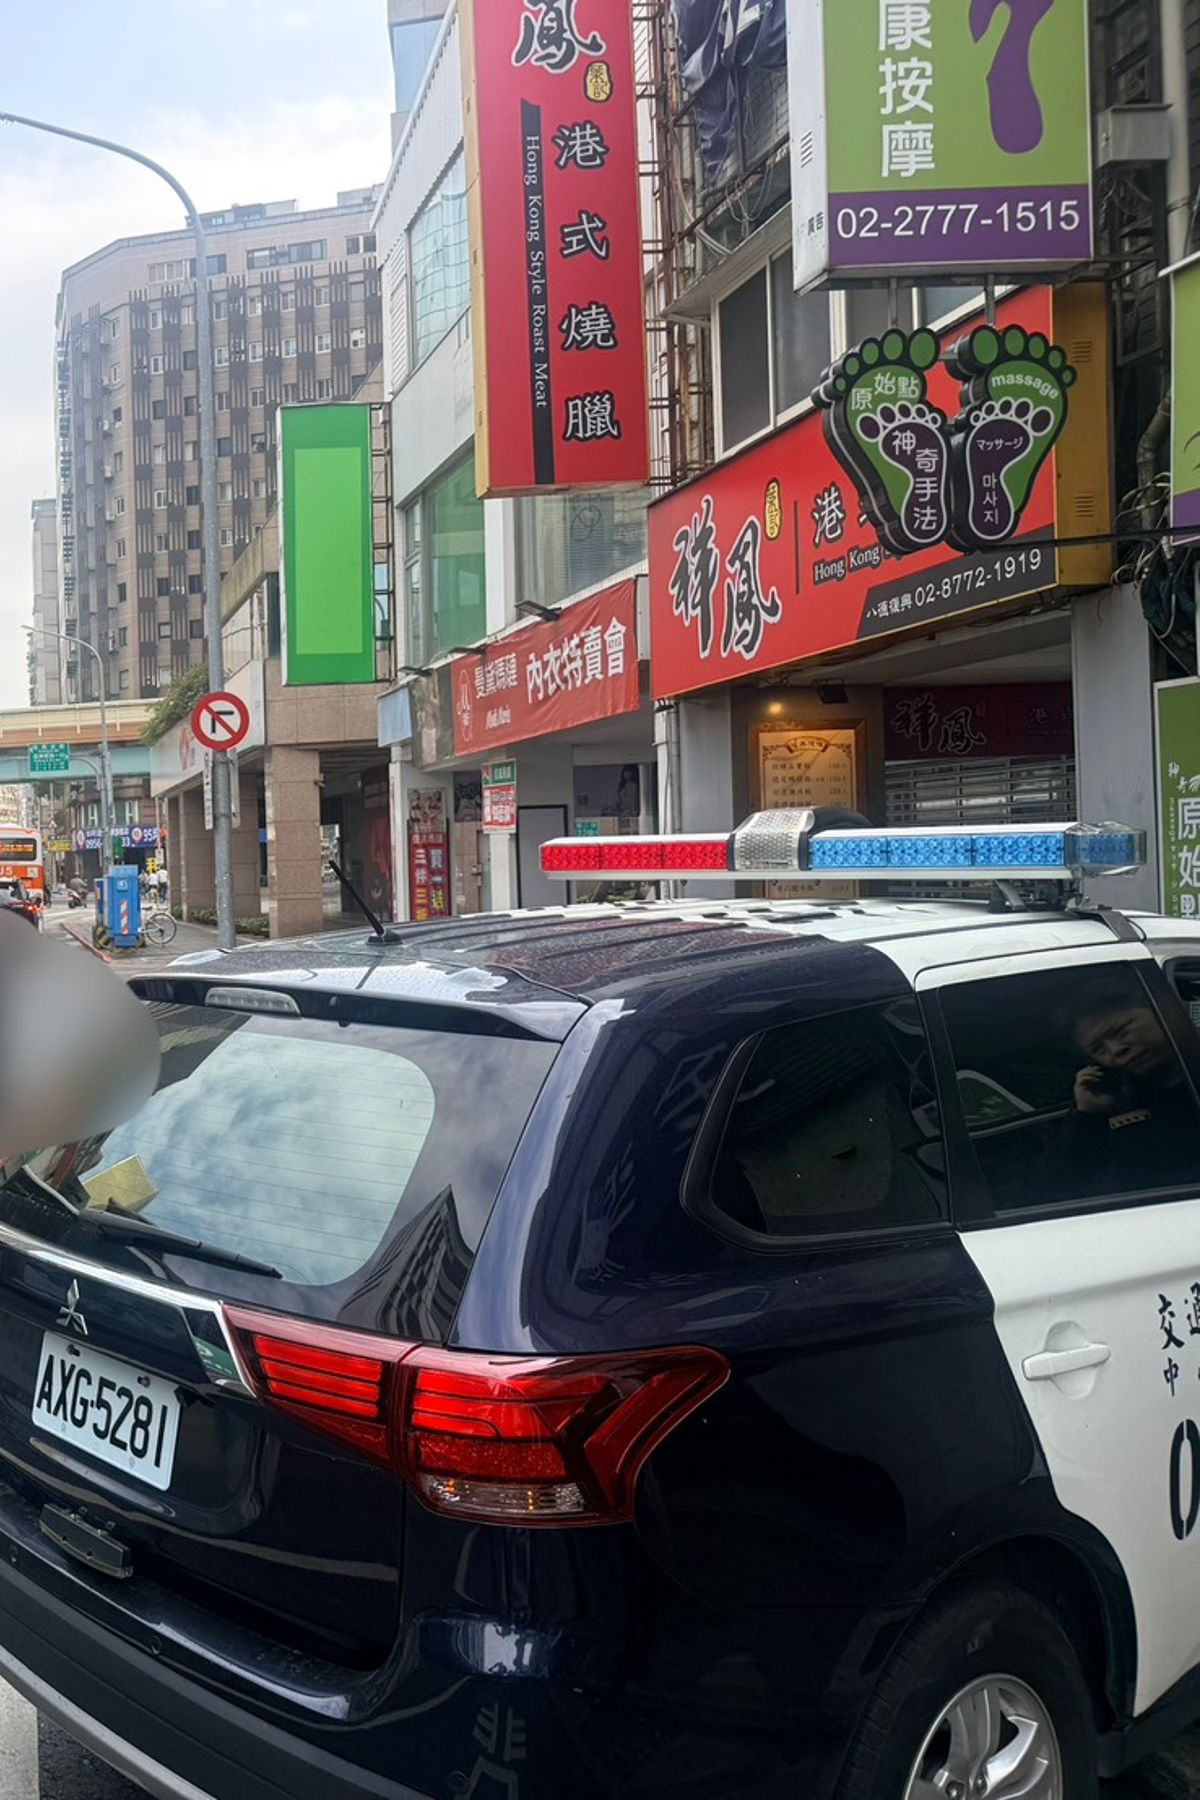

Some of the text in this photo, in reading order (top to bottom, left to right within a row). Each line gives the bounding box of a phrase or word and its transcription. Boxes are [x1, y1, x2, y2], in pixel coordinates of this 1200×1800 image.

[877, 0, 935, 178] 康按摩
[836, 201, 1080, 238] 02-2777-1515
[524, 135, 548, 407] Hong Kong Style Roast Meat
[552, 121, 619, 441] 港式燒臘
[851, 372, 919, 410] 原始點
[991, 373, 1060, 400] massage
[891, 430, 940, 531] 神奇手法
[976, 437, 1024, 451] マッサージ
[982, 473, 1000, 526] 마사지
[669, 495, 782, 659] 祥鳳
[814, 558, 845, 583] Hong
[849, 547, 881, 569] Kong
[914, 548, 1042, 607] 02-8772-1919
[526, 616, 627, 704] 內衣特賣會
[36, 1354, 168, 1468] AXG-5281
